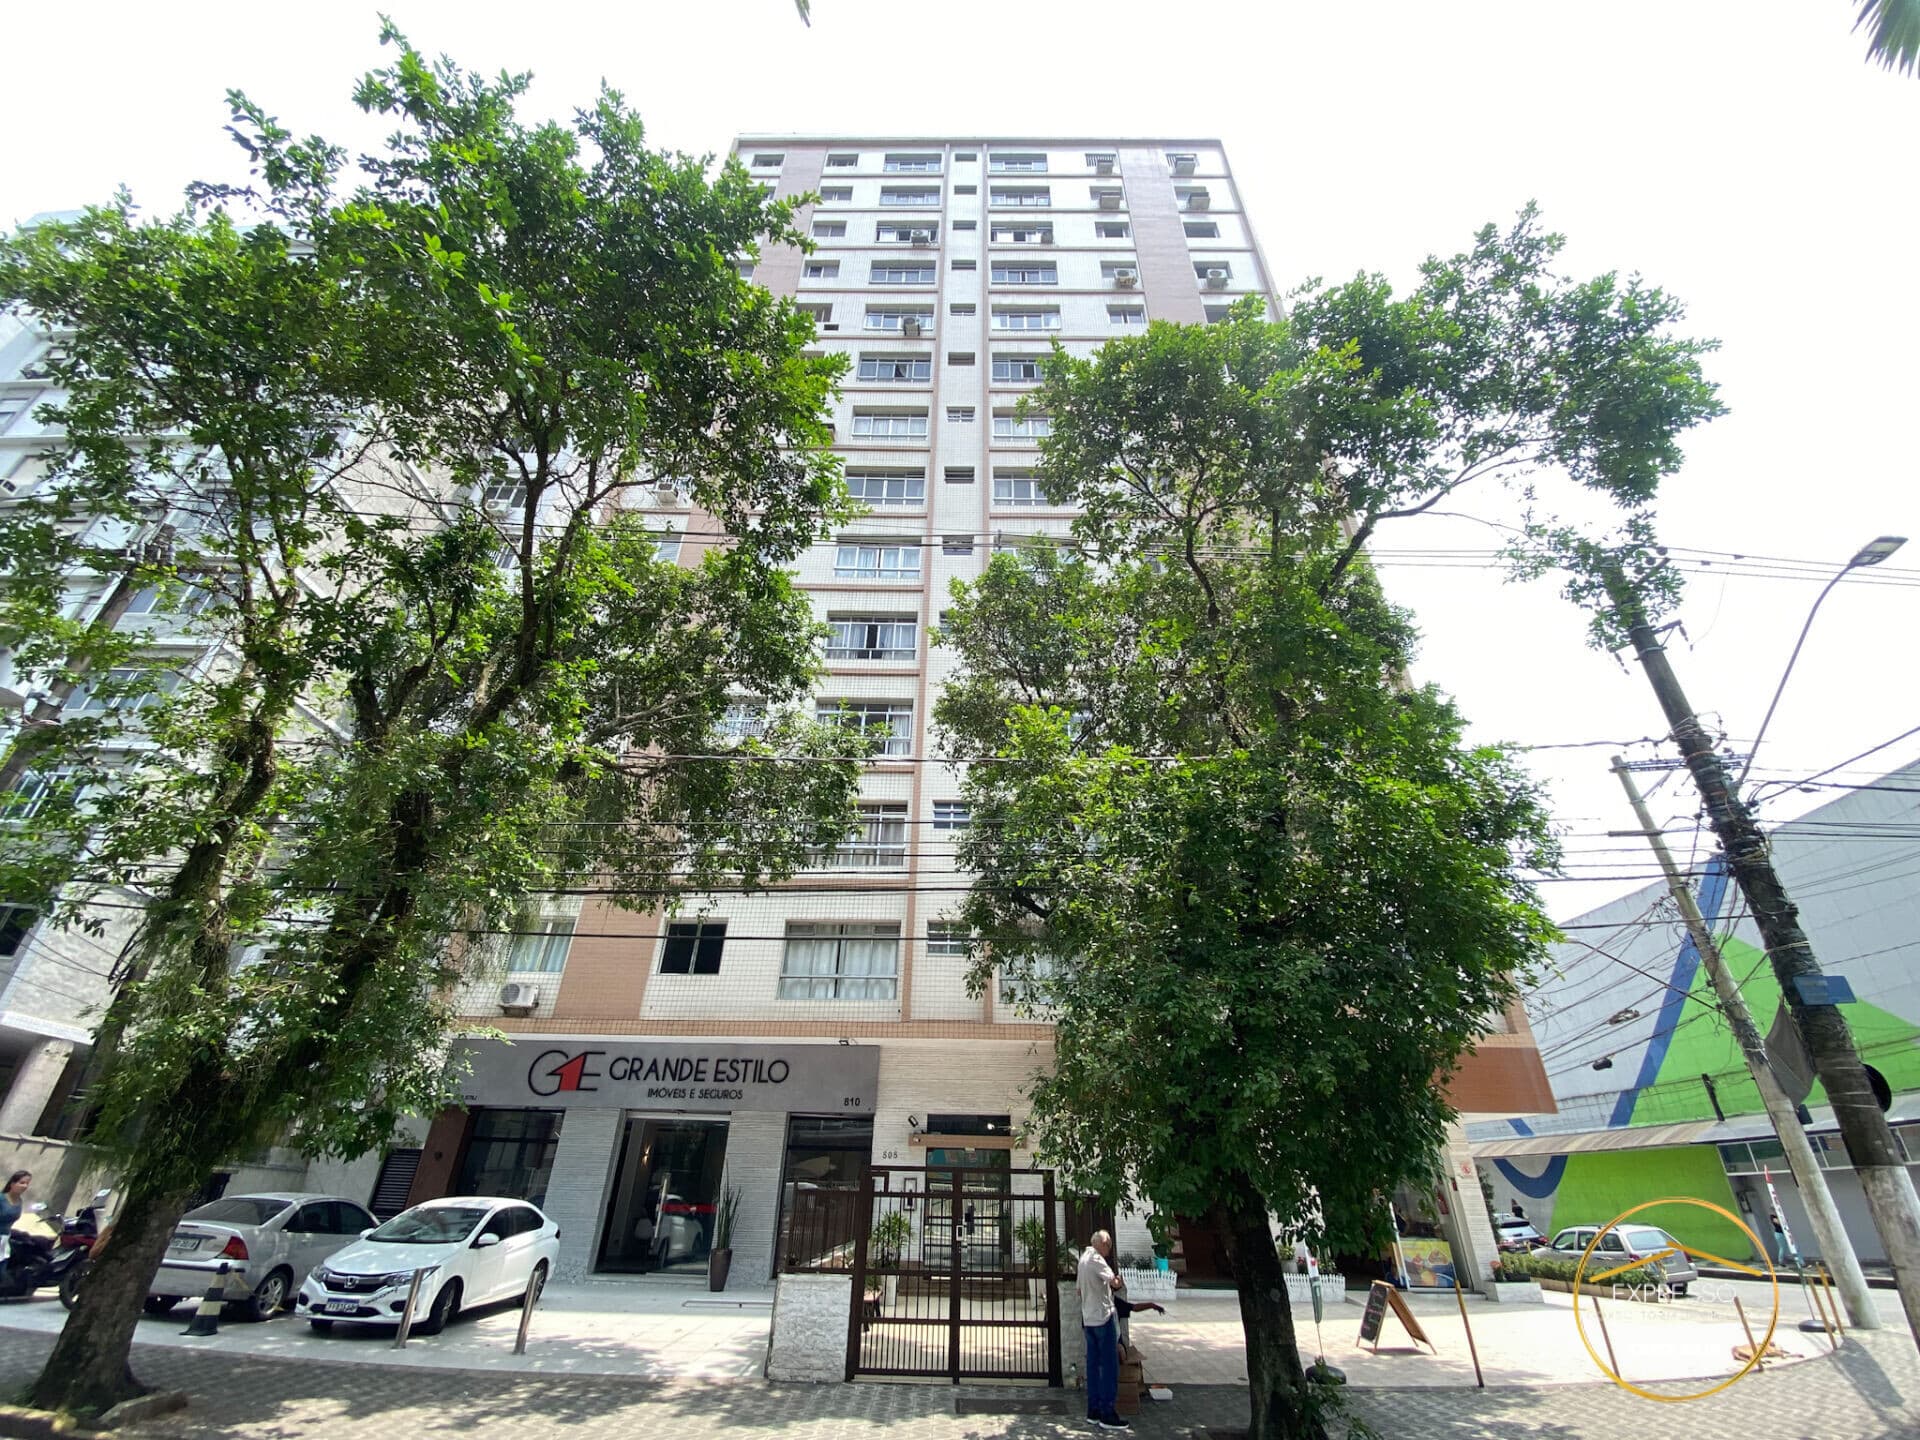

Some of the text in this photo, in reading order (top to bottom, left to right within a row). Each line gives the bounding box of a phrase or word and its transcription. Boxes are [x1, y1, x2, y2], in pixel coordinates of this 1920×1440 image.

[609, 1056, 790, 1084] GRANDE ESTILO
[689, 1088, 696, 1099] E
[697, 1088, 743, 1100] SEGUROS
